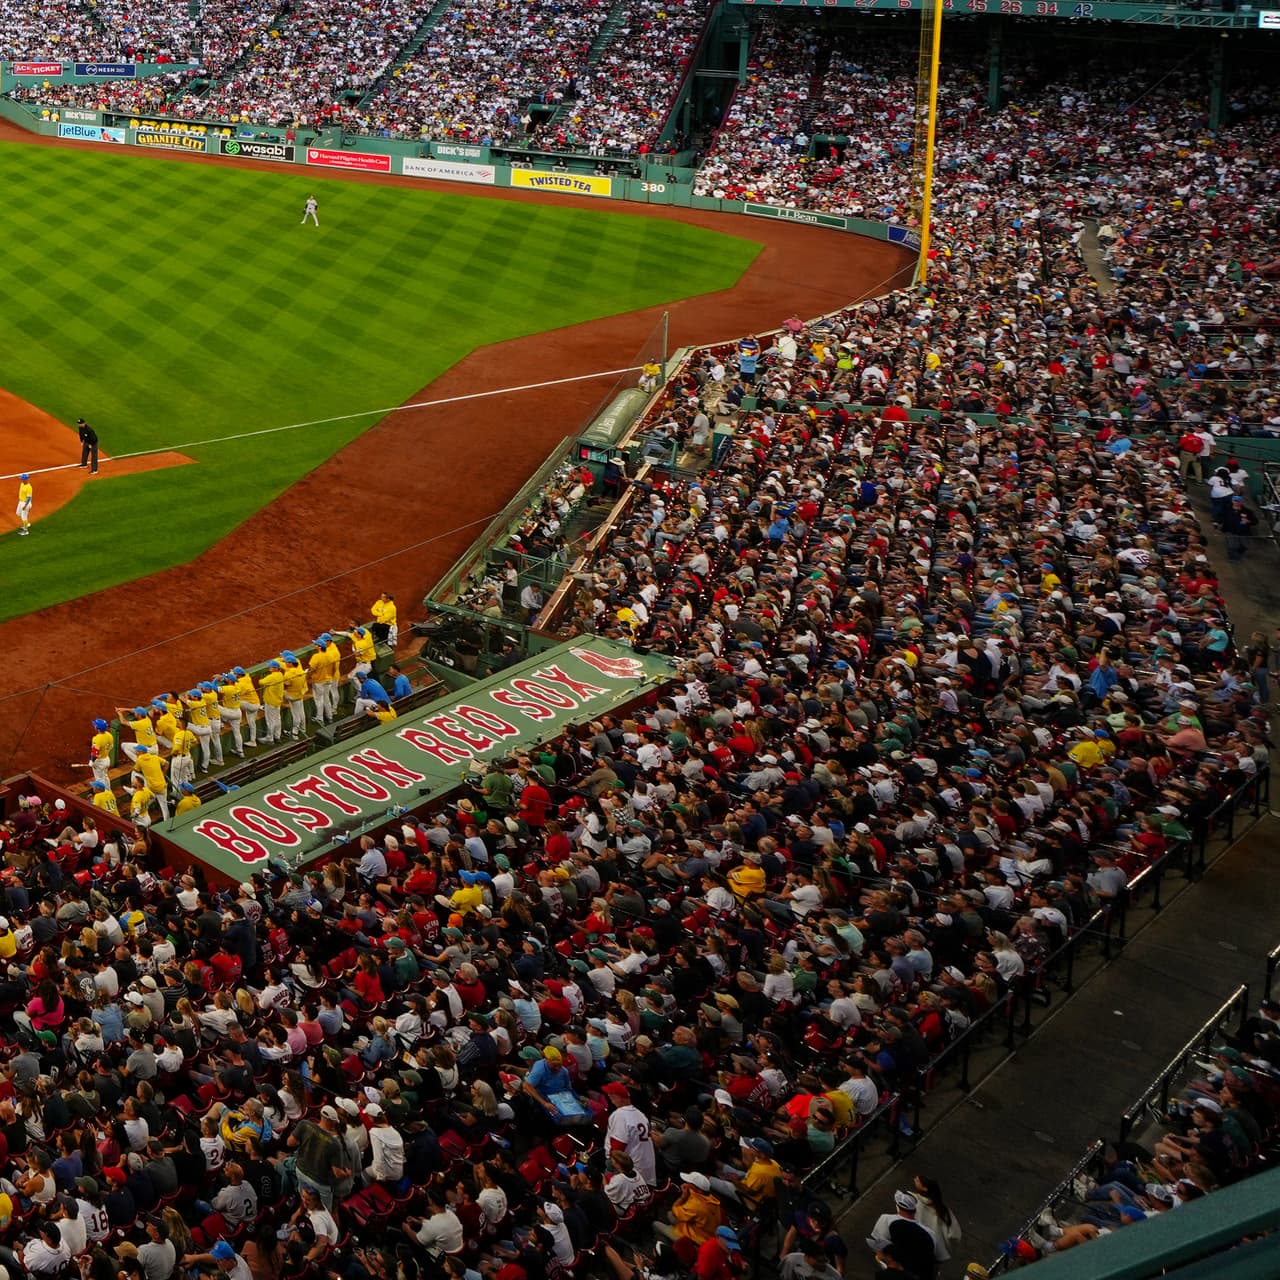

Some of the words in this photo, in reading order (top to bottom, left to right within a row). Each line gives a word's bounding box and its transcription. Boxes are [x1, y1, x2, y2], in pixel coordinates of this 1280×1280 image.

[966, 0, 987, 12] 45
[1000, 0, 1021, 14] 26
[1036, 2, 1057, 15] 34
[1073, 3, 1093, 17] 42
[33, 65, 60, 74] TICKET
[62, 126, 96, 138] jetBlue
[138, 133, 181, 145] GRANITE
[182, 136, 205, 150] CITY
[241, 144, 286, 156] wasabi
[437, 146, 465, 156] DICK'S
[405, 164, 426, 172] BANK
[439, 168, 474, 177] AMERICA
[529, 177, 572, 187] TWISTED
[573, 180, 592, 192] TEA
[641, 182, 665, 193] 380
[777, 209, 817, 223] L.L.Bean
[193, 748, 426, 864] BOSTON
[396, 705, 521, 766] RED
[489, 664, 611, 721] SOX
[91, 1210, 107, 1233] 18
